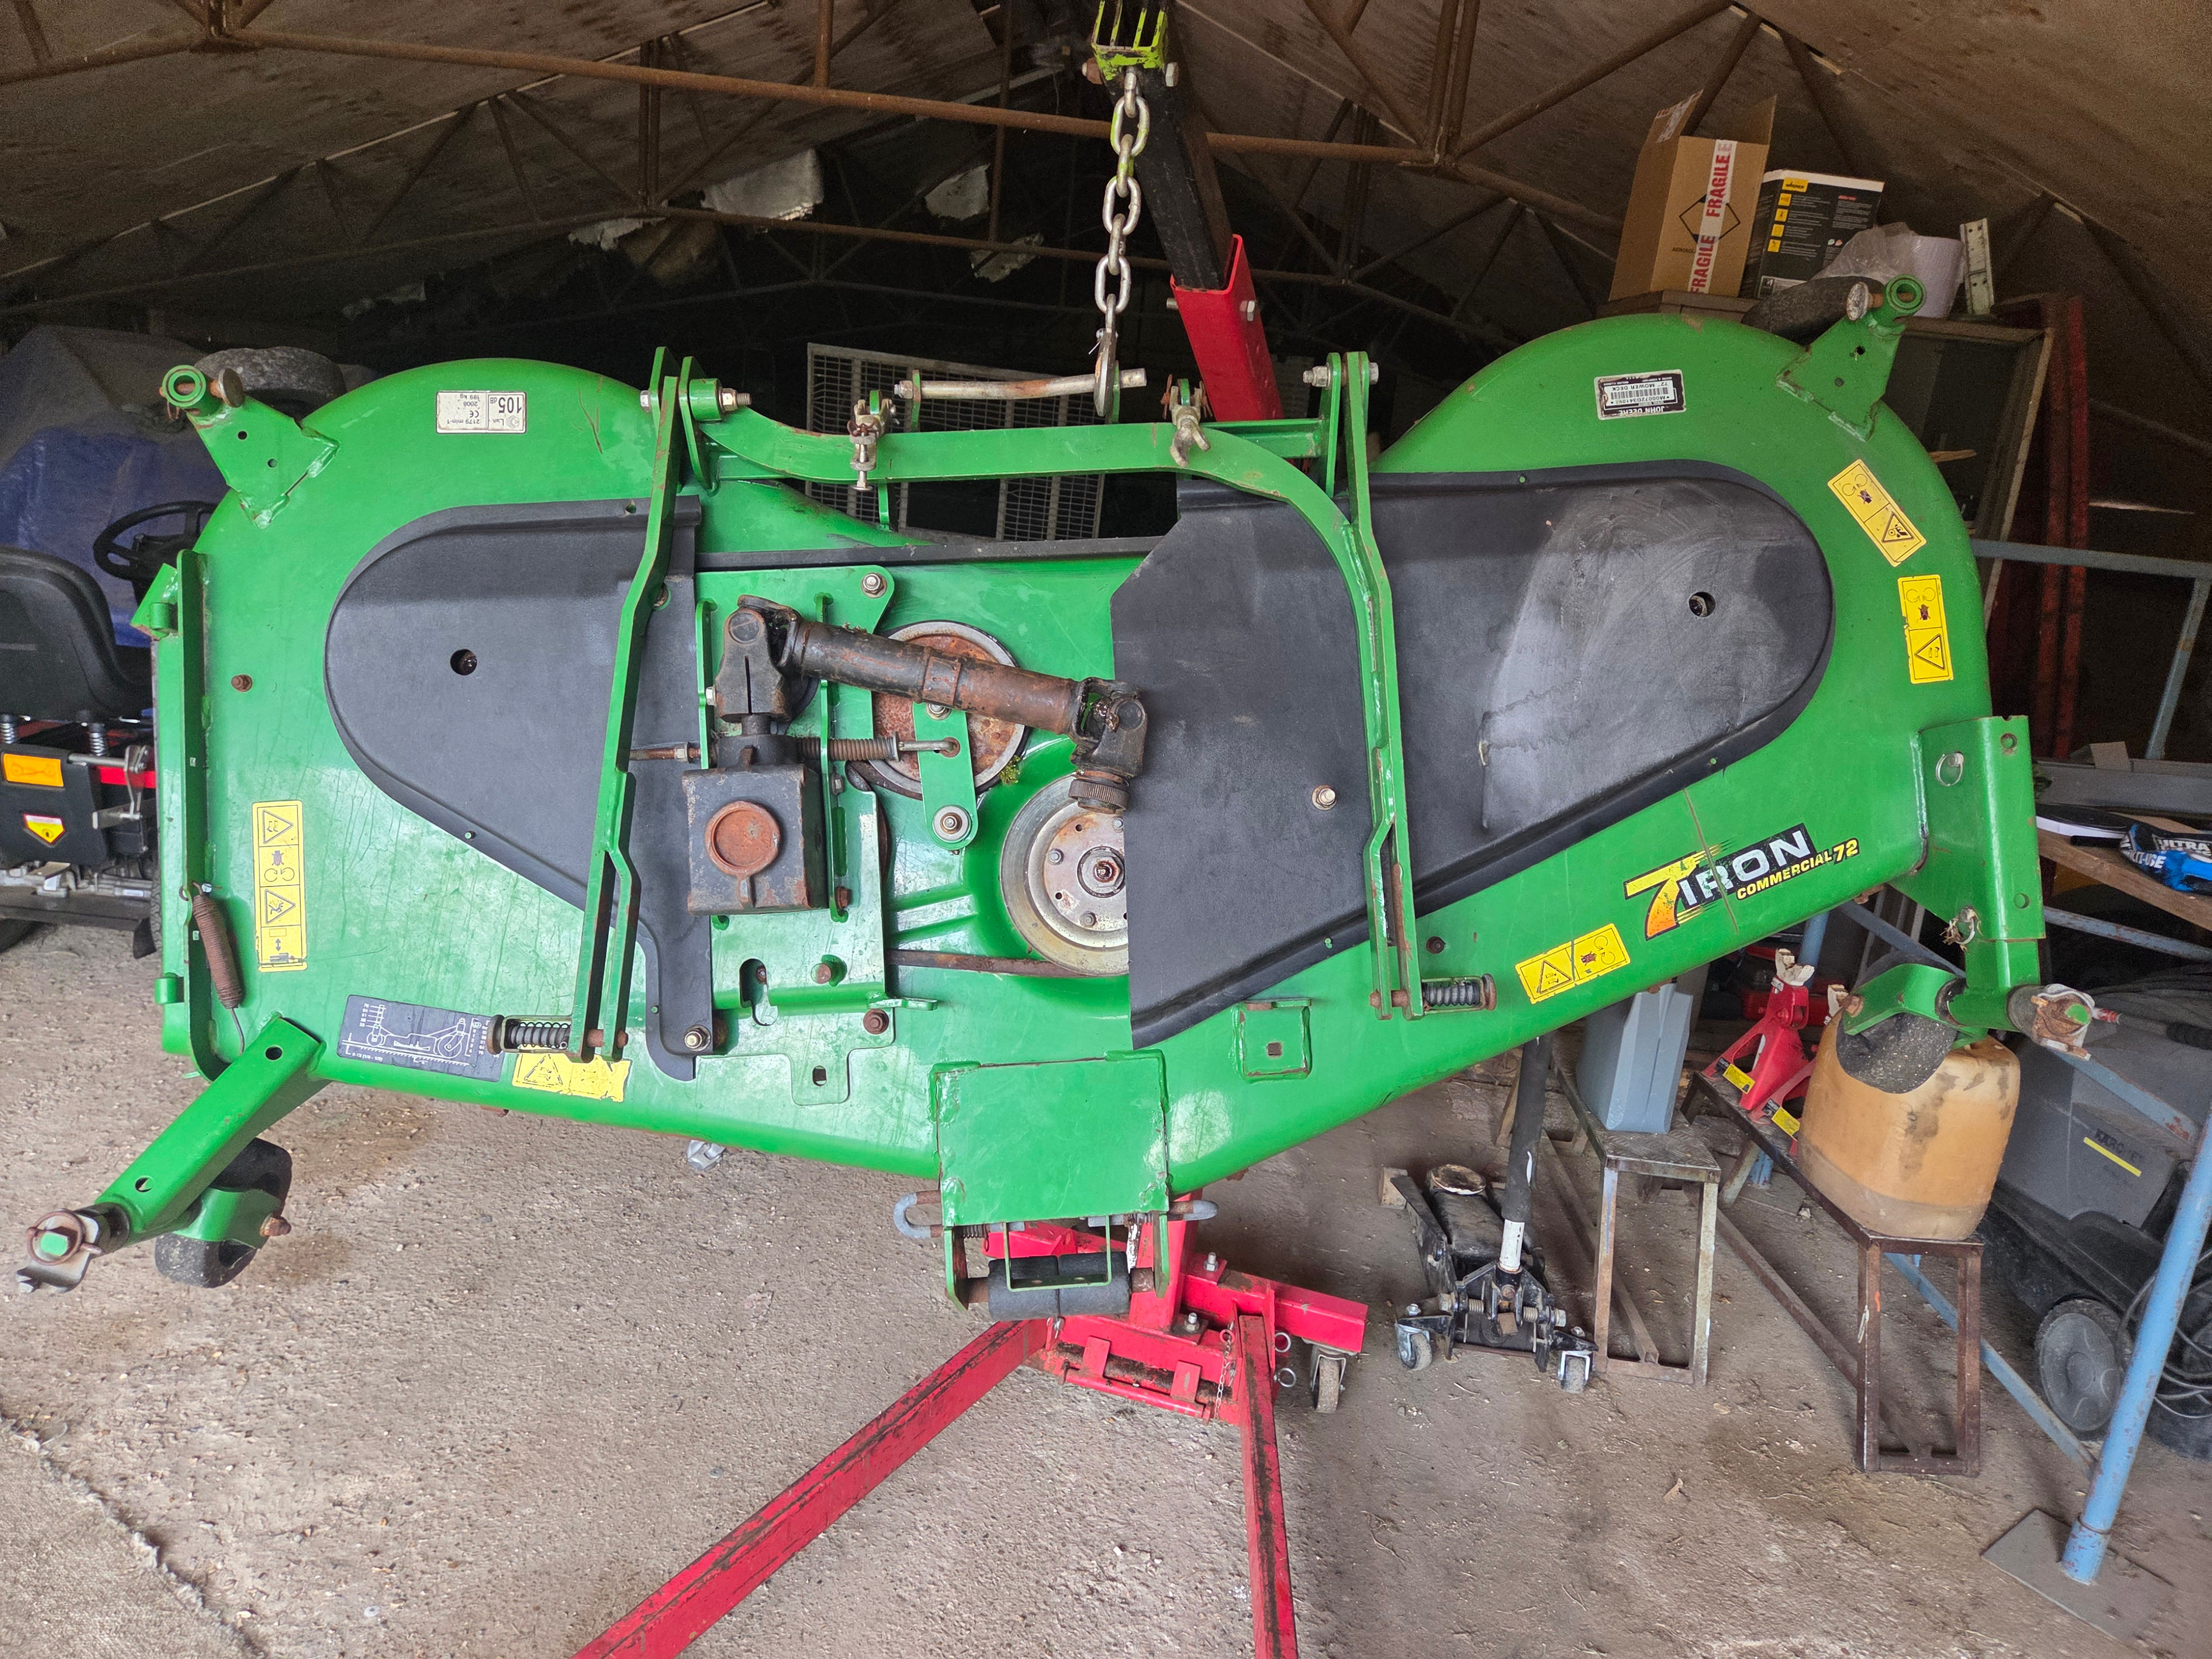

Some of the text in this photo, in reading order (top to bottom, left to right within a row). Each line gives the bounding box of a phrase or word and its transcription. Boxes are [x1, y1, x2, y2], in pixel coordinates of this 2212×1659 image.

[1706, 153, 1730, 217] FRAGILE
[498, 397, 521, 414] 105
[1642, 405, 1665, 414] JOHN
[1736, 838, 1859, 900] COMMERCIAL 72
